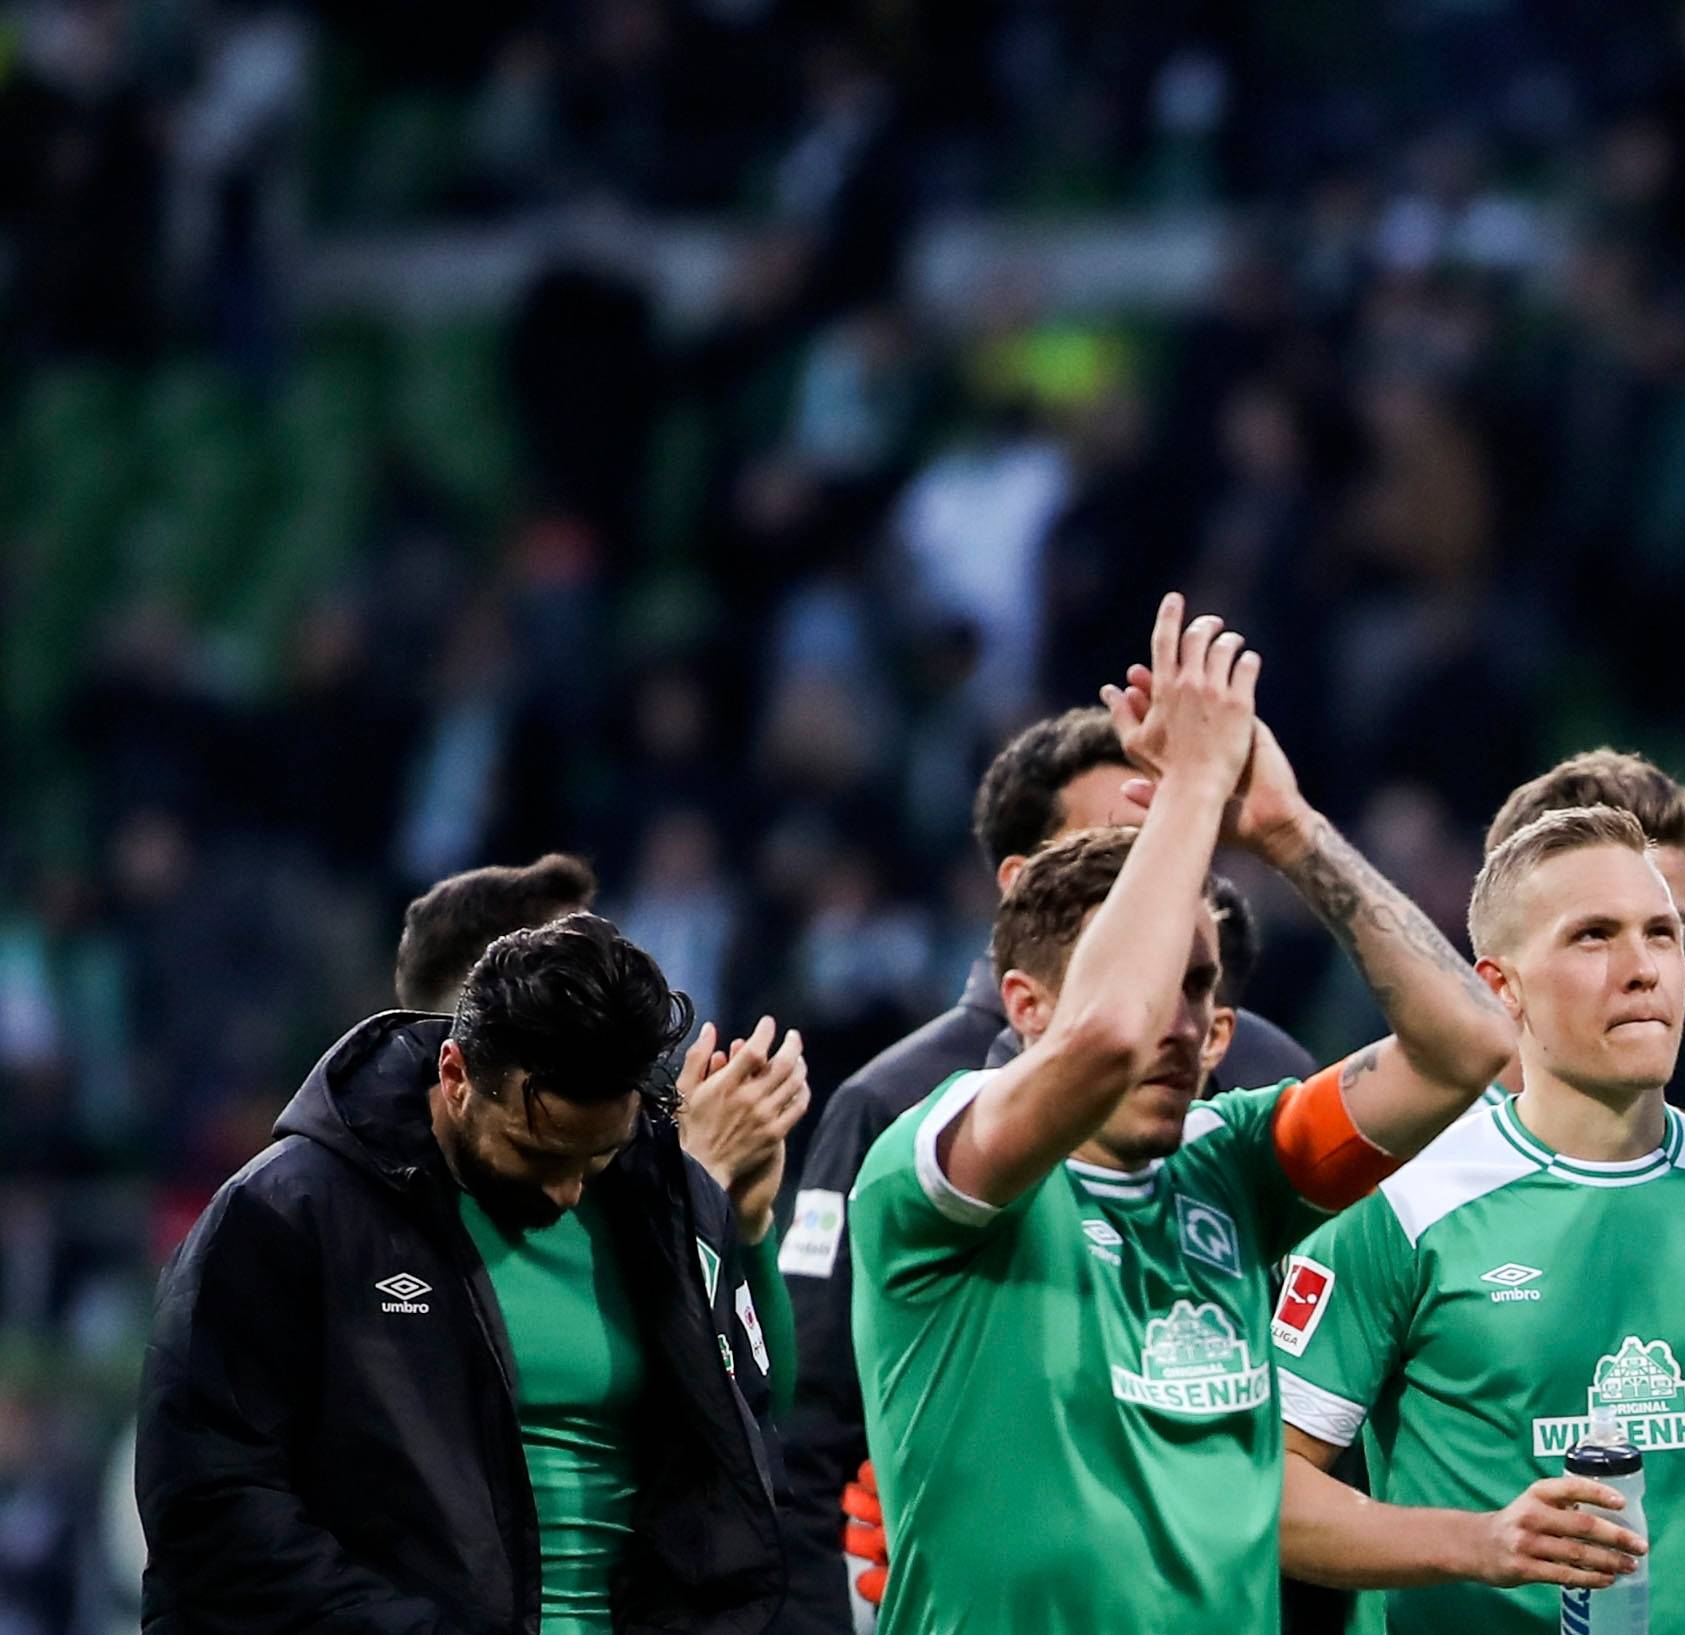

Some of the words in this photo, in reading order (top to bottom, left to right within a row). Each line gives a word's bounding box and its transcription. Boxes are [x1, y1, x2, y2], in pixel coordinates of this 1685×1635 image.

[1491, 1287, 1541, 1303] umbro
[381, 1300, 430, 1314] umbro
[1271, 1325, 1299, 1346] LIGA
